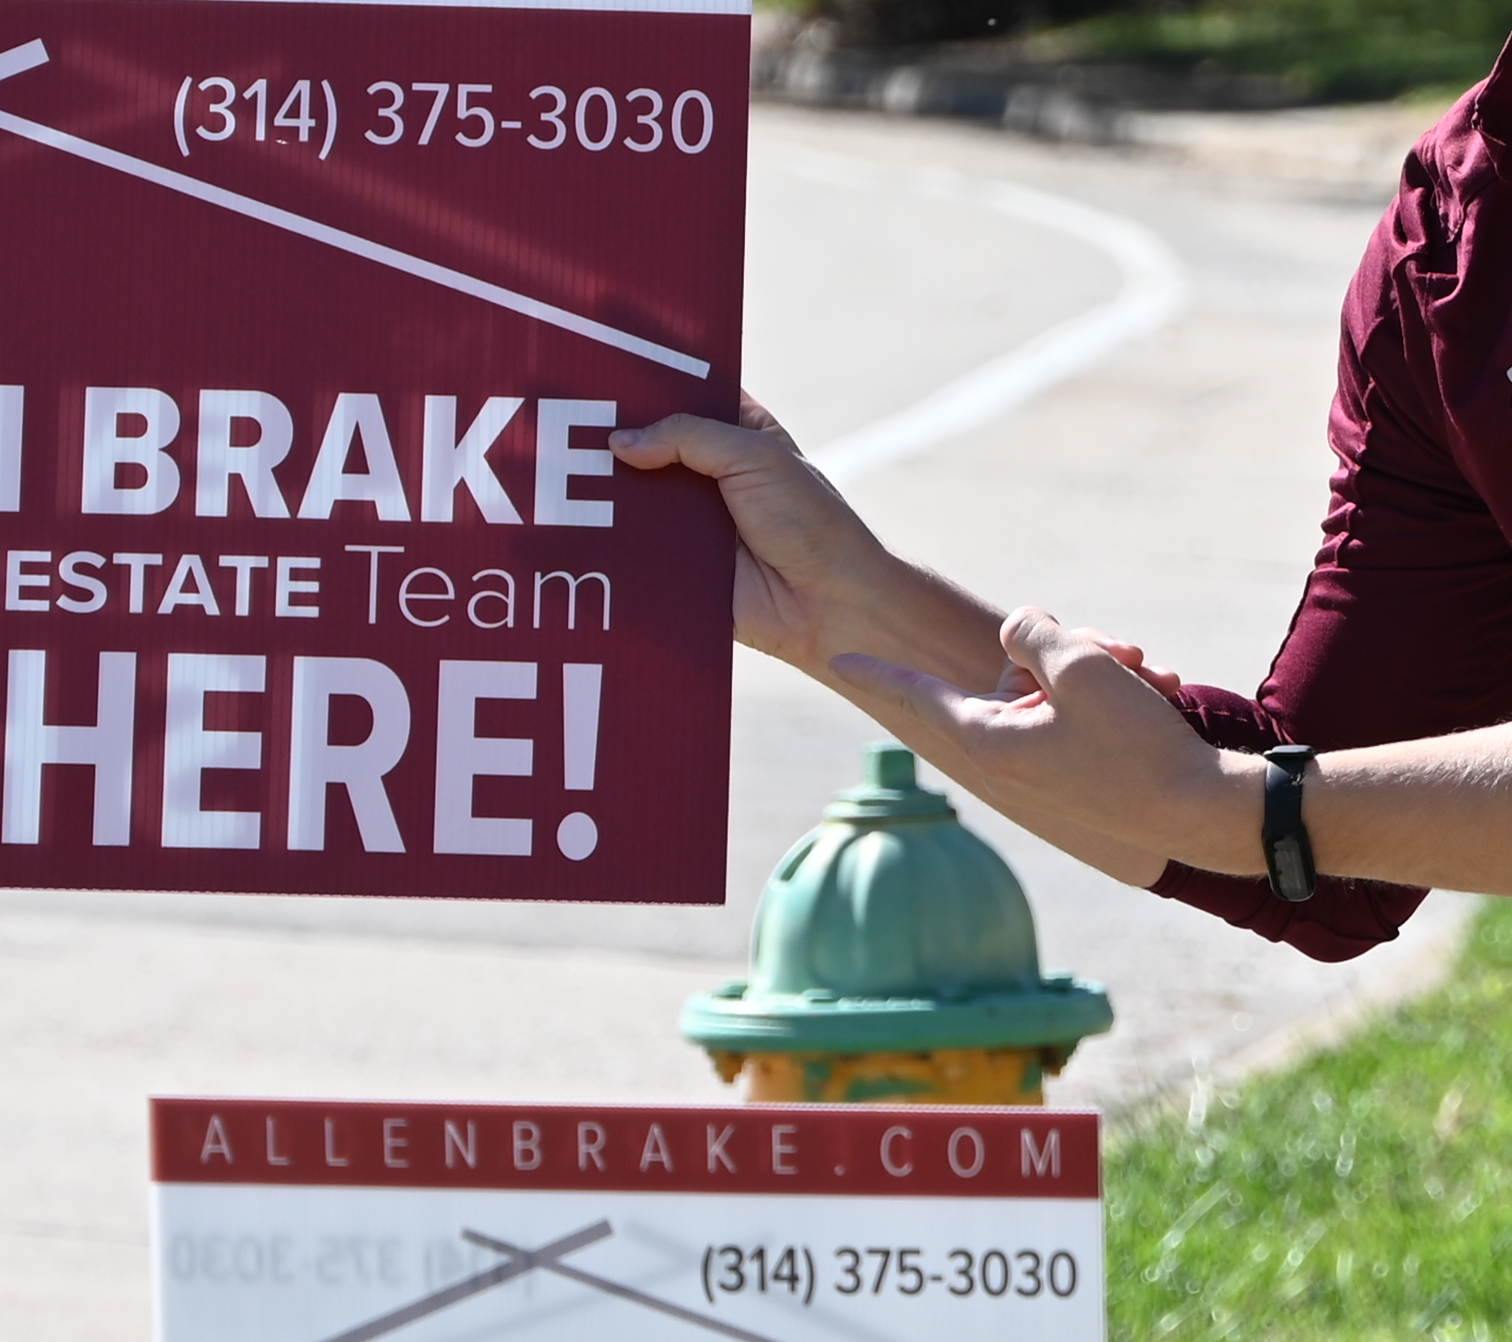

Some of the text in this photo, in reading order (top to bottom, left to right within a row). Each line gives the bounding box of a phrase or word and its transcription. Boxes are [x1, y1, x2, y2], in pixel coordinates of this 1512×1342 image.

[172, 75, 715, 161] (314) 375-3030
[81, 384, 617, 529] BRAKE
[4, 549, 322, 619] ESTATE
[344, 543, 613, 632] Team
[1, 648, 604, 861] HERE!
[201, 1116, 1063, 1180] ALLENBRAKE.COM
[699, 1244, 1079, 1306] (314) 375-3030
